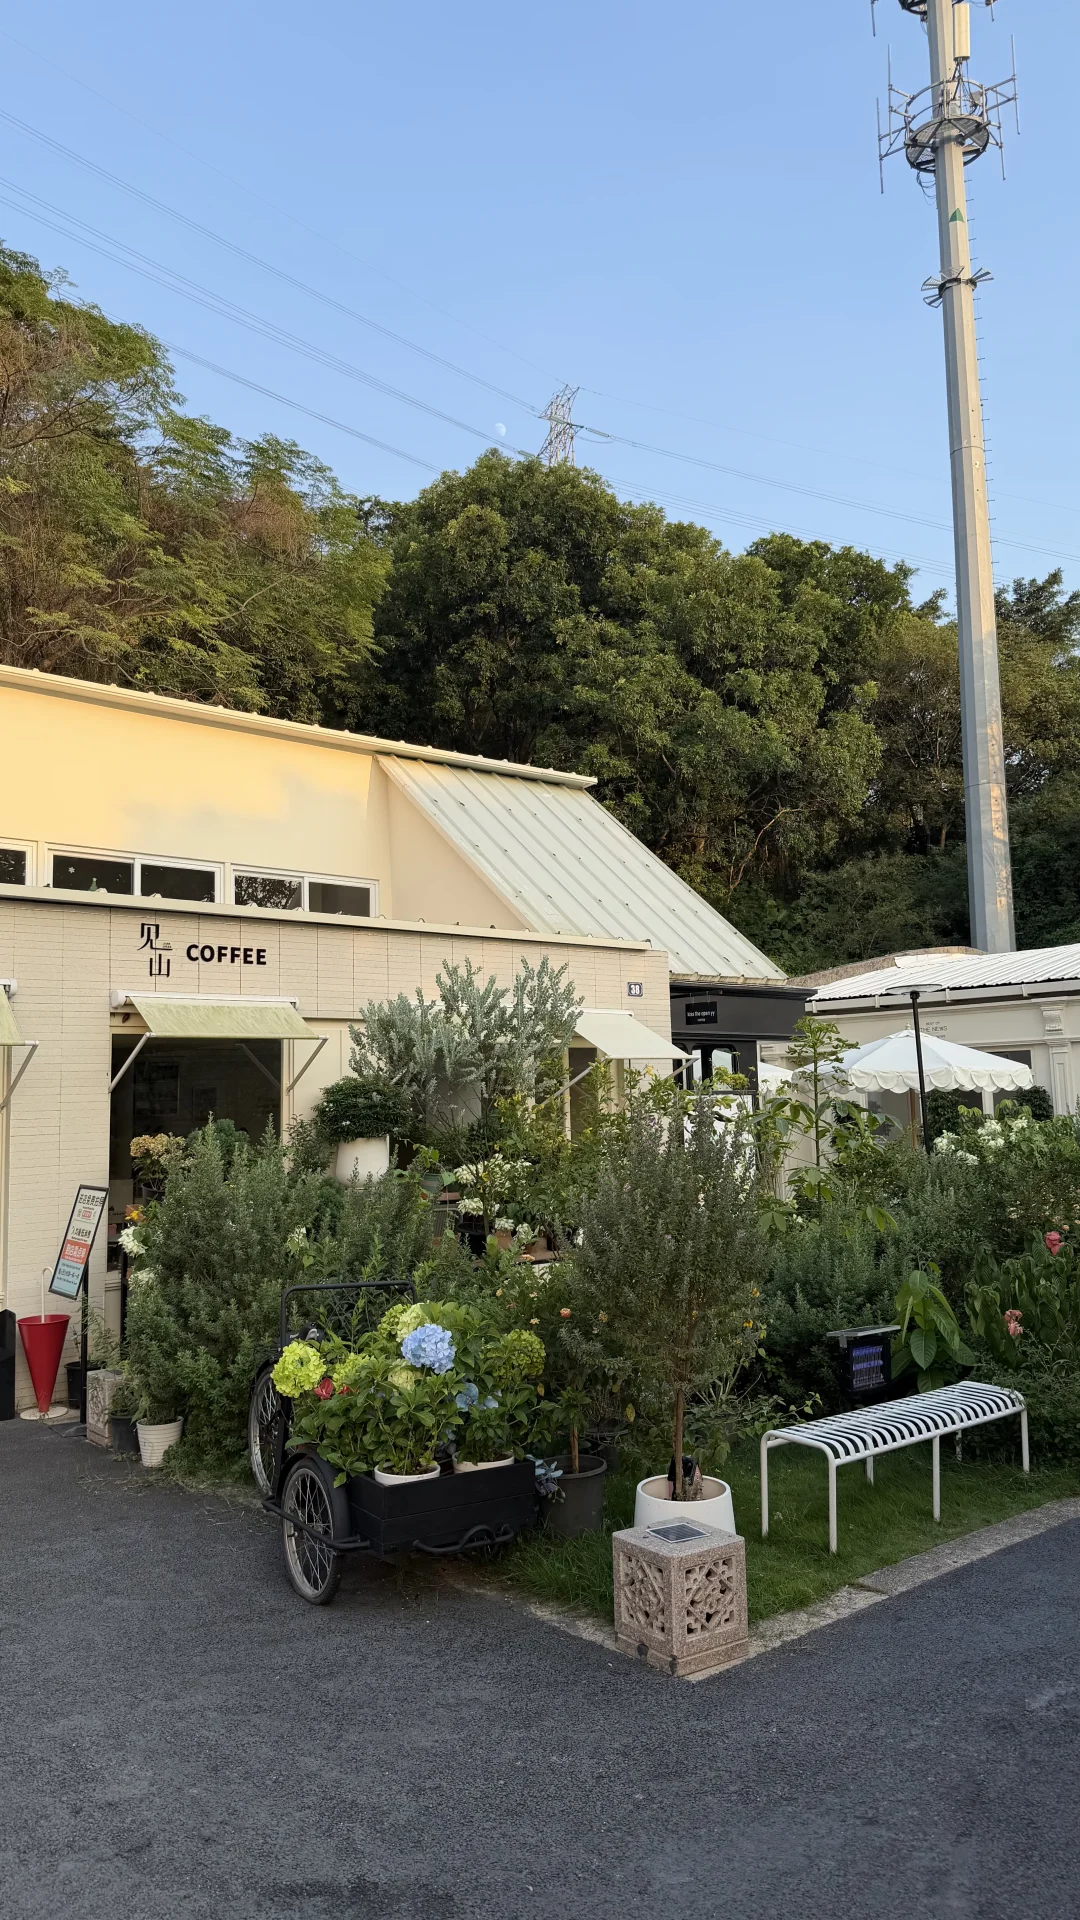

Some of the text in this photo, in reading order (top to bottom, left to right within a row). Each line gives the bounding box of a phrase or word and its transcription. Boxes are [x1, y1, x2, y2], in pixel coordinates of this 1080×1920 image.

[137, 923, 173, 978] 见山
[186, 944, 267, 965] COFFEE
[630, 984, 640, 995] 38
